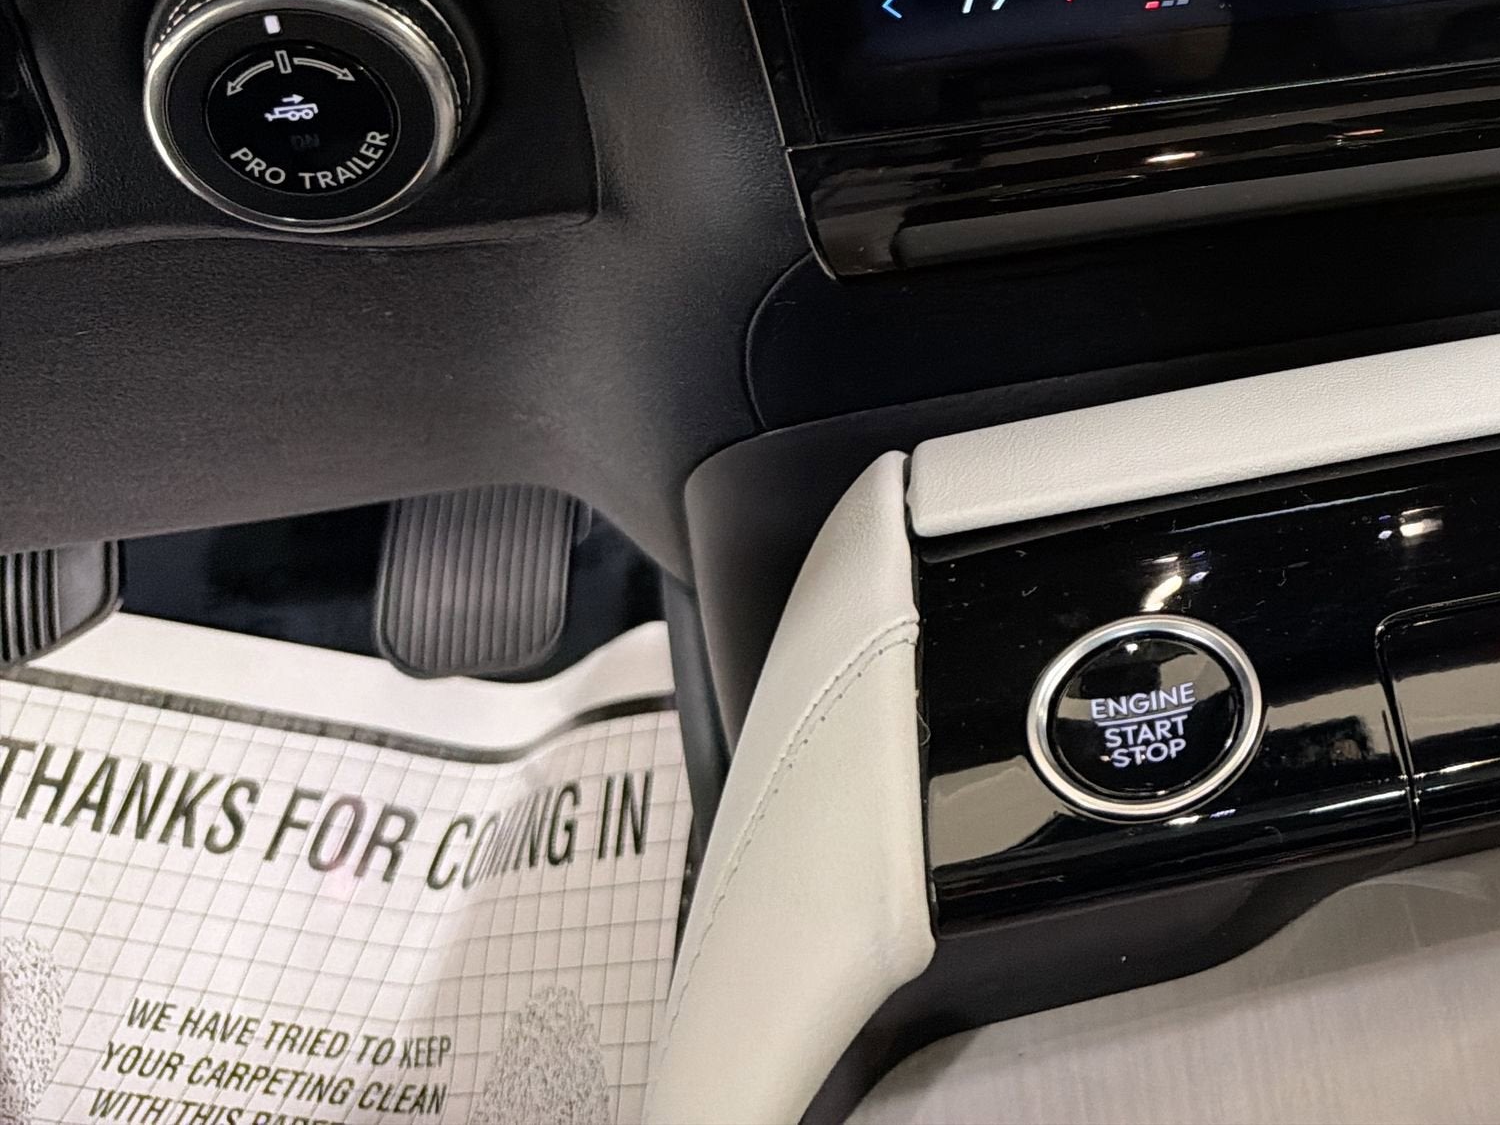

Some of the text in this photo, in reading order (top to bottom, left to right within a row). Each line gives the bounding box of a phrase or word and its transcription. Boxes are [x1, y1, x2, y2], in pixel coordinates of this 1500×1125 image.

[230, 131, 390, 190] PRO TRAILER
[1091, 682, 1196, 720] ENGINE
[1104, 715, 1189, 748] START
[1111, 738, 1187, 768] STOP
[0, 735, 260, 856] THANKS
[263, 784, 419, 884] FOR
[597, 769, 656, 861] IN
[127, 997, 452, 1070] WE HAVE TRIED TO KEEP
[100, 1040, 448, 1116] YOUR CARPETING CLEAN
[89, 1088, 174, 1125] WITH
